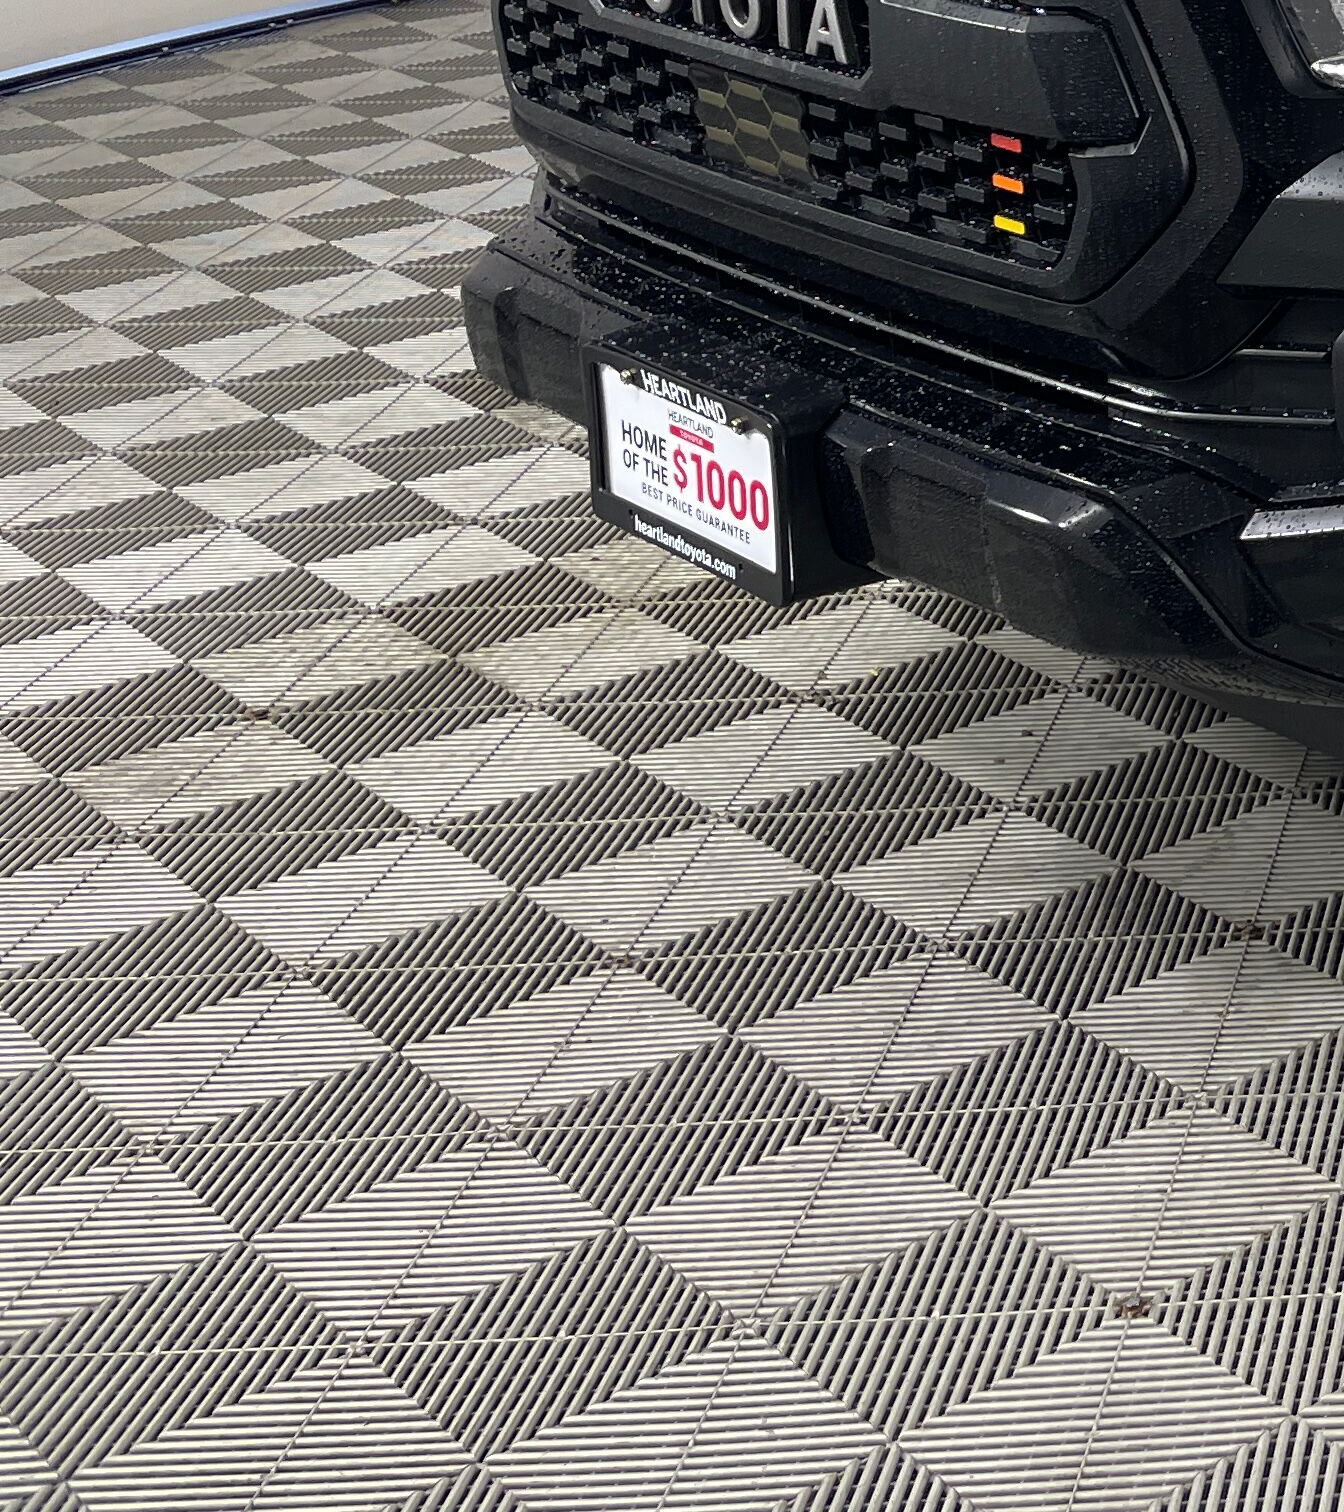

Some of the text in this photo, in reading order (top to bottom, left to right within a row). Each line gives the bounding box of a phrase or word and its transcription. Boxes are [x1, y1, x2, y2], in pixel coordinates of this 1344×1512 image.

[640, 369, 727, 424] HEARTLAND
[668, 409, 713, 438] HEARTLAND
[621, 419, 667, 461] HOME
[623, 449, 668, 486] OF THE
[642, 482, 750, 545] BEST PRICE GUARANTEE
[673, 444, 769, 531] $1000
[635, 514, 736, 580] heartlandtoyota.com
